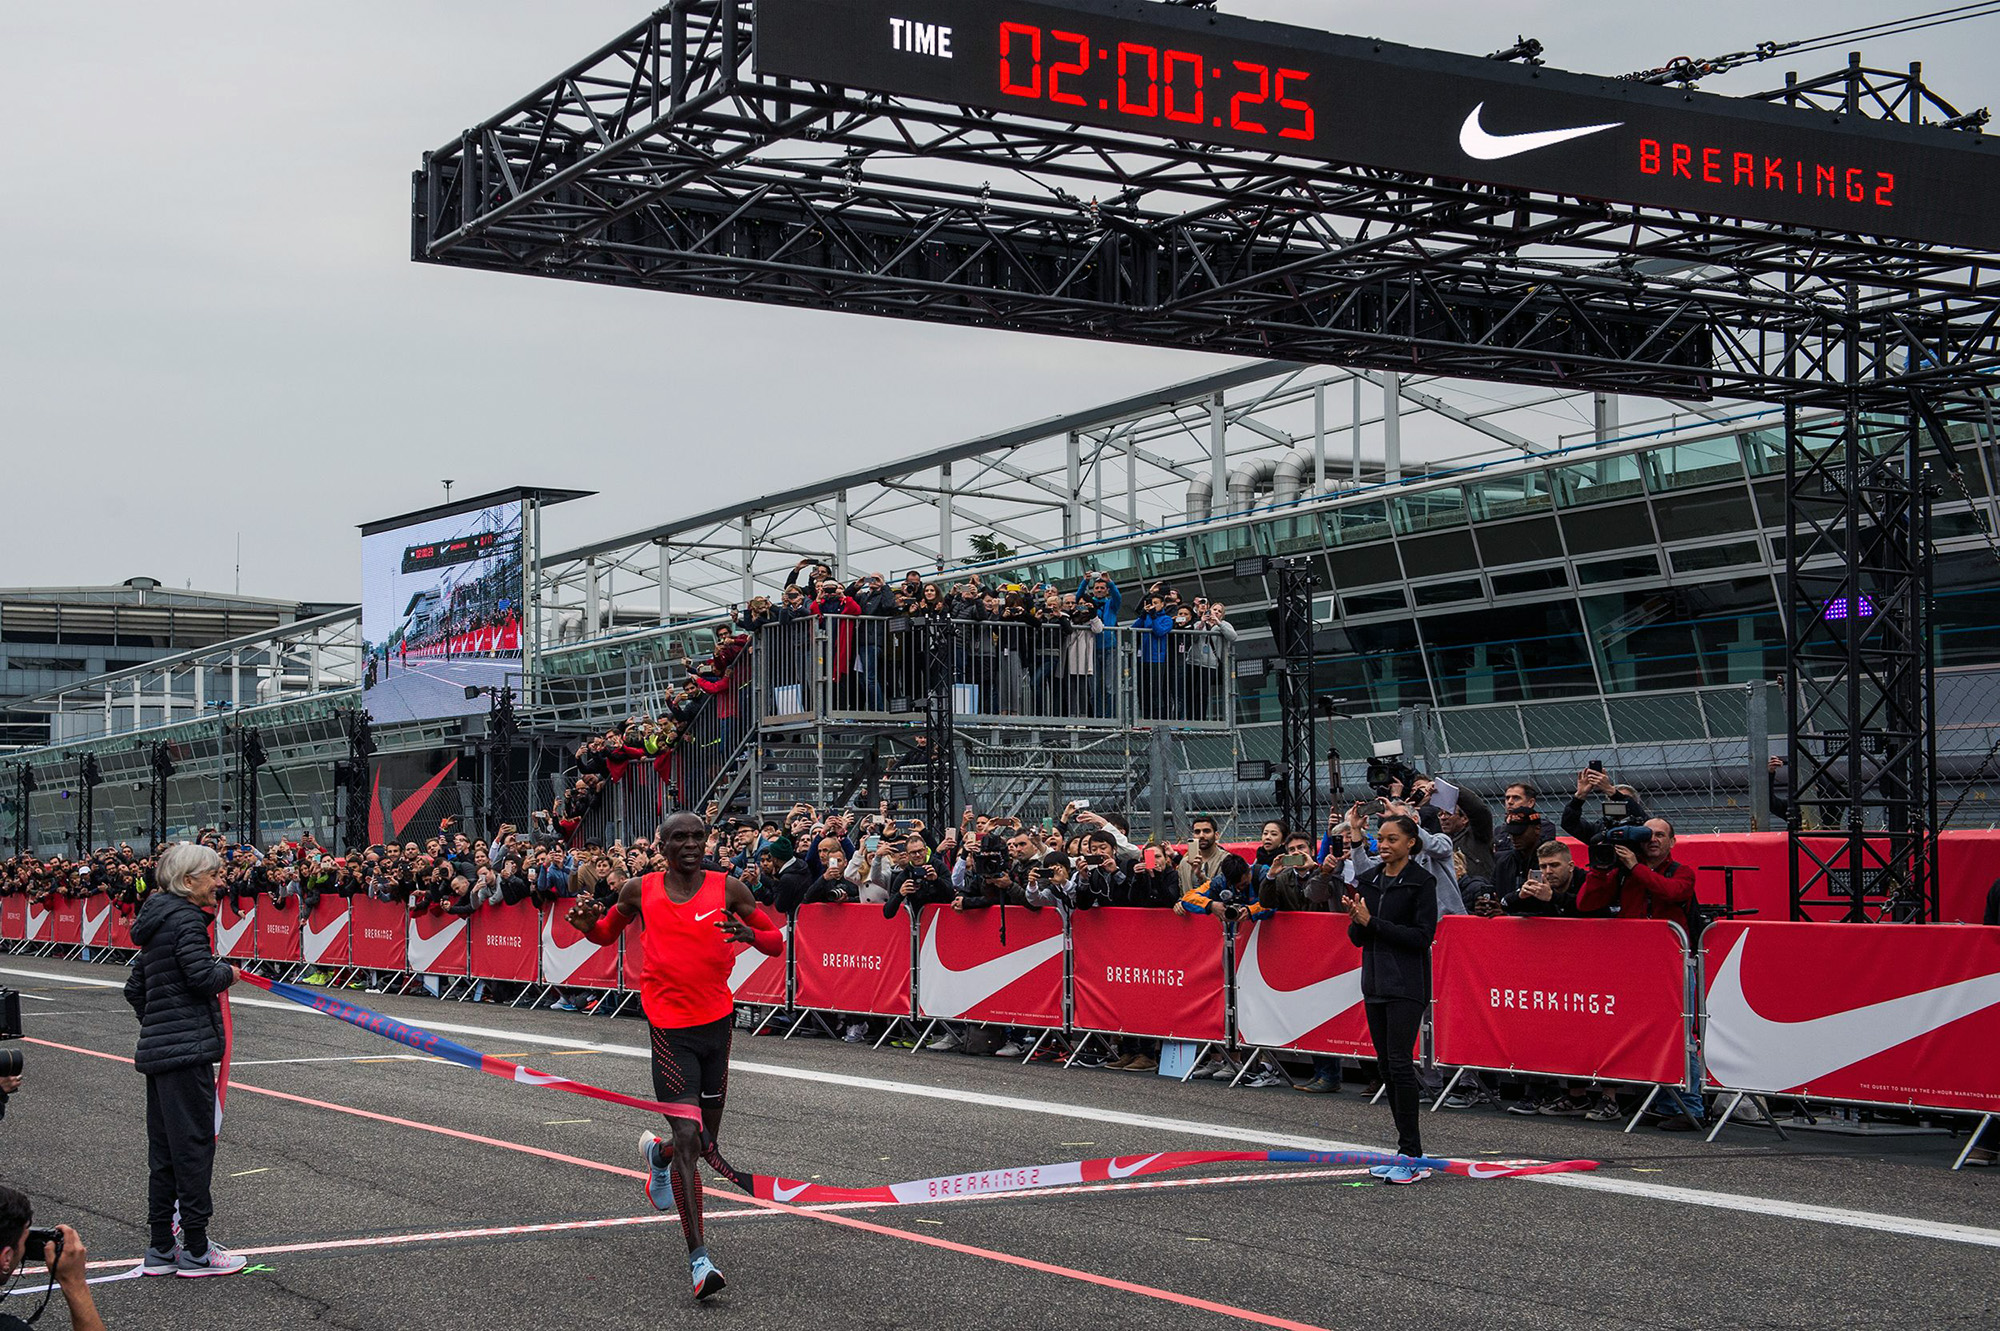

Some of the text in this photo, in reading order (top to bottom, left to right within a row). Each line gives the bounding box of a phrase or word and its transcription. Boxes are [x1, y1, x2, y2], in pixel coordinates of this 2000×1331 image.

[889, 17, 953, 58] TIME
[1000, 21, 1315, 141] 02:00:25
[1639, 138, 1895, 207] BREAKING2
[364, 928, 393, 940] BREAKING2
[486, 934, 522, 947] BREAKING2
[822, 952, 882, 970] BREAKING2
[1106, 966, 1185, 987] BREAKING2
[1490, 988, 1616, 1016] BREAKING2
[1955, 1090, 1984, 1098] MARATHON
[928, 1169, 1040, 1197] BREAKING2
